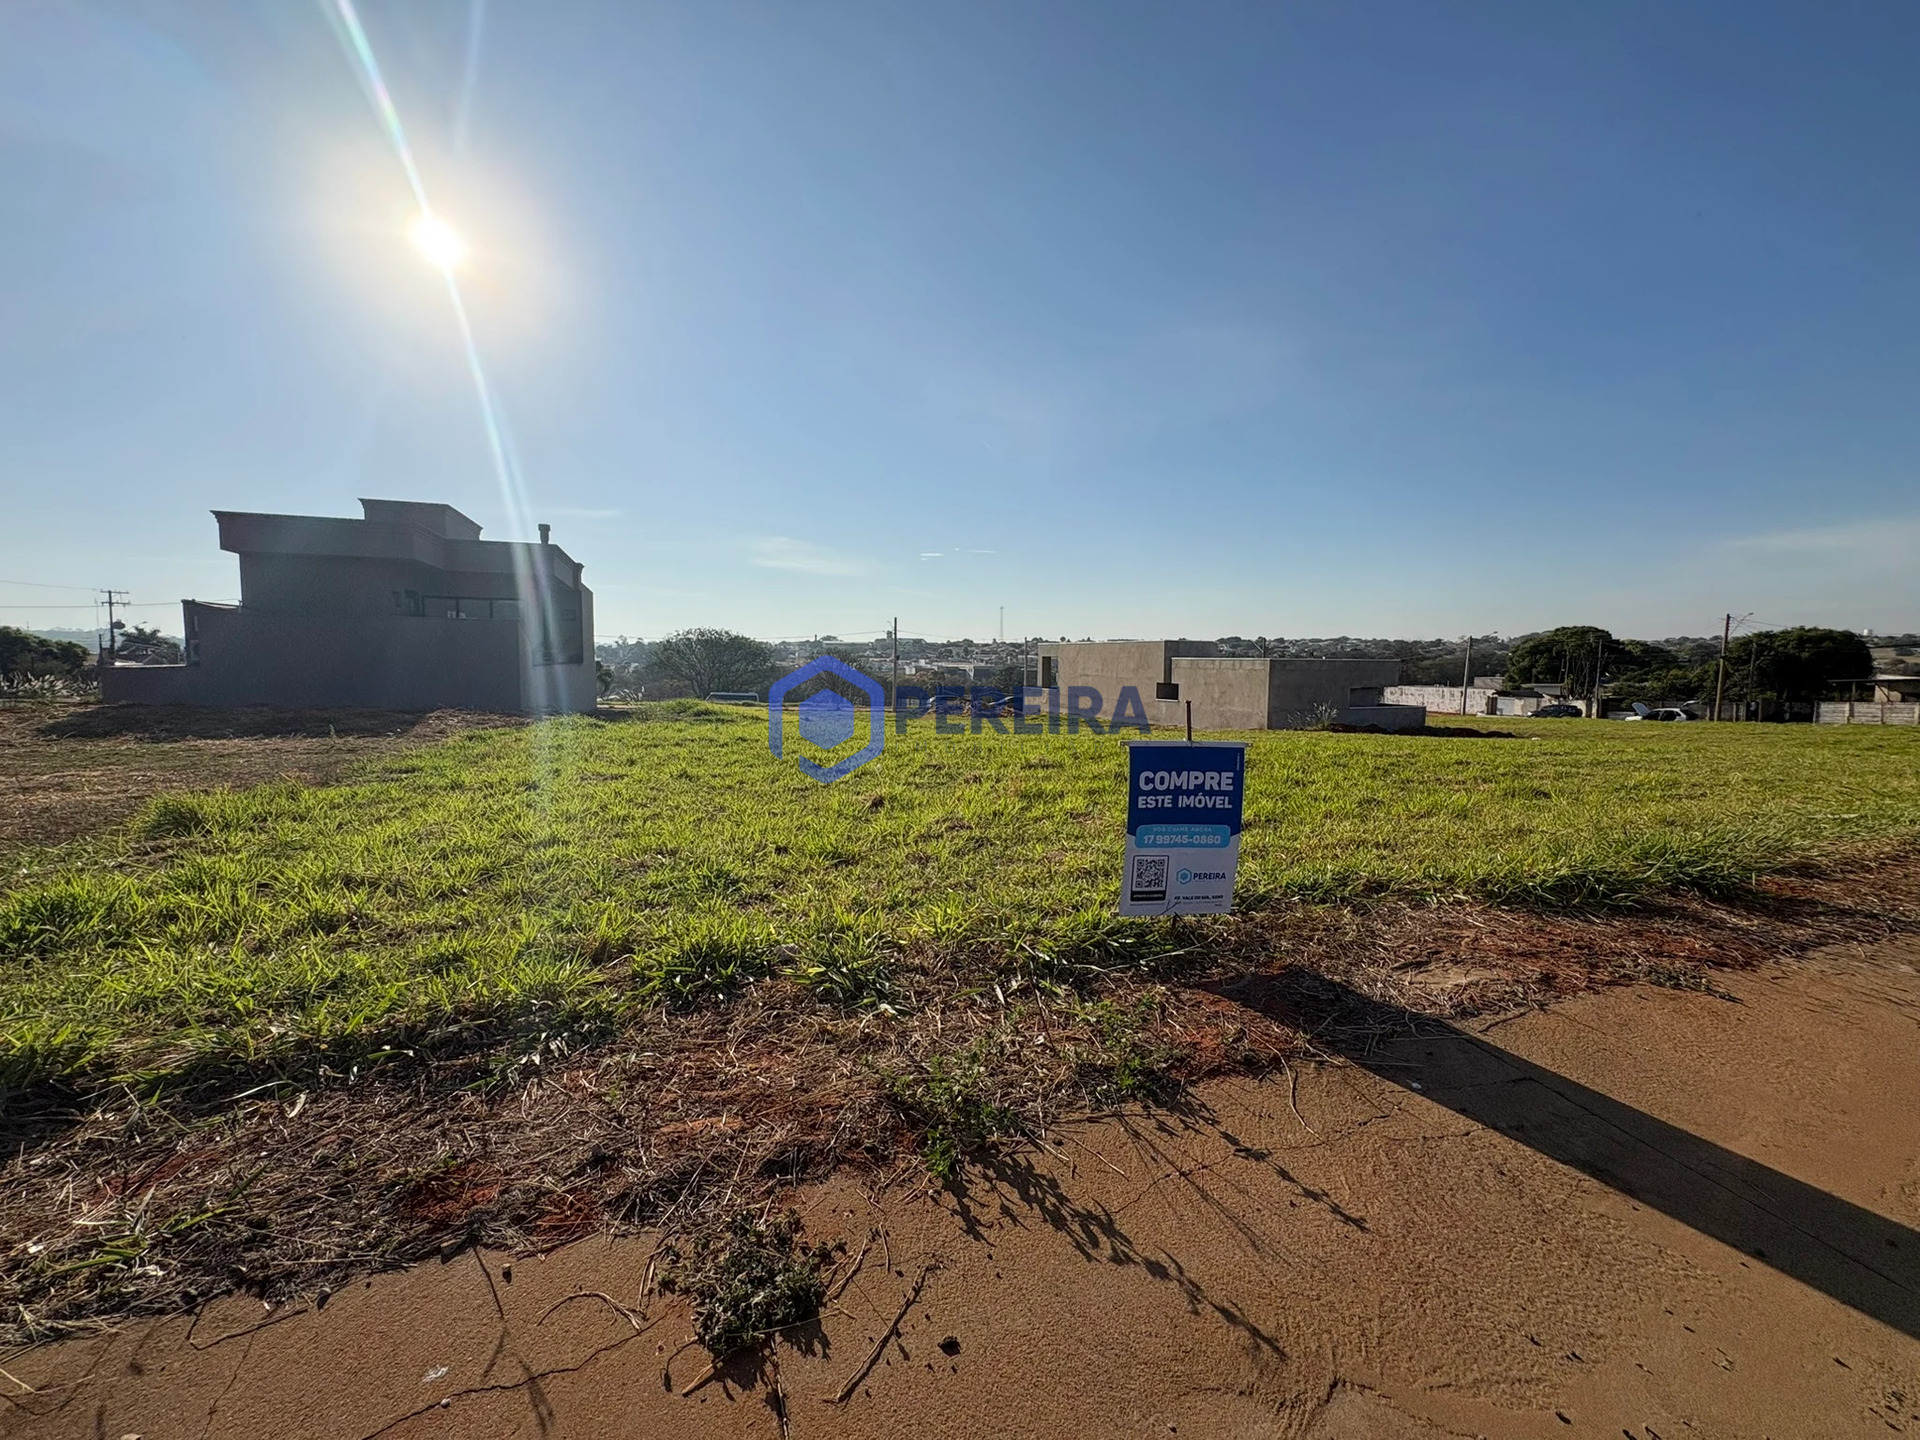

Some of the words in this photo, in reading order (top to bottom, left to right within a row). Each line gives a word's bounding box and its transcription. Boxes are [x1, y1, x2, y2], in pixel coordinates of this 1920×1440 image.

[1139, 770, 1234, 791] COMPRE
[1137, 795, 1173, 809] ESTE
[1177, 792, 1233, 809] IMÓVEL
[1155, 834, 1222, 844] 99745-0860
[1193, 872, 1226, 880] PEREIRA
